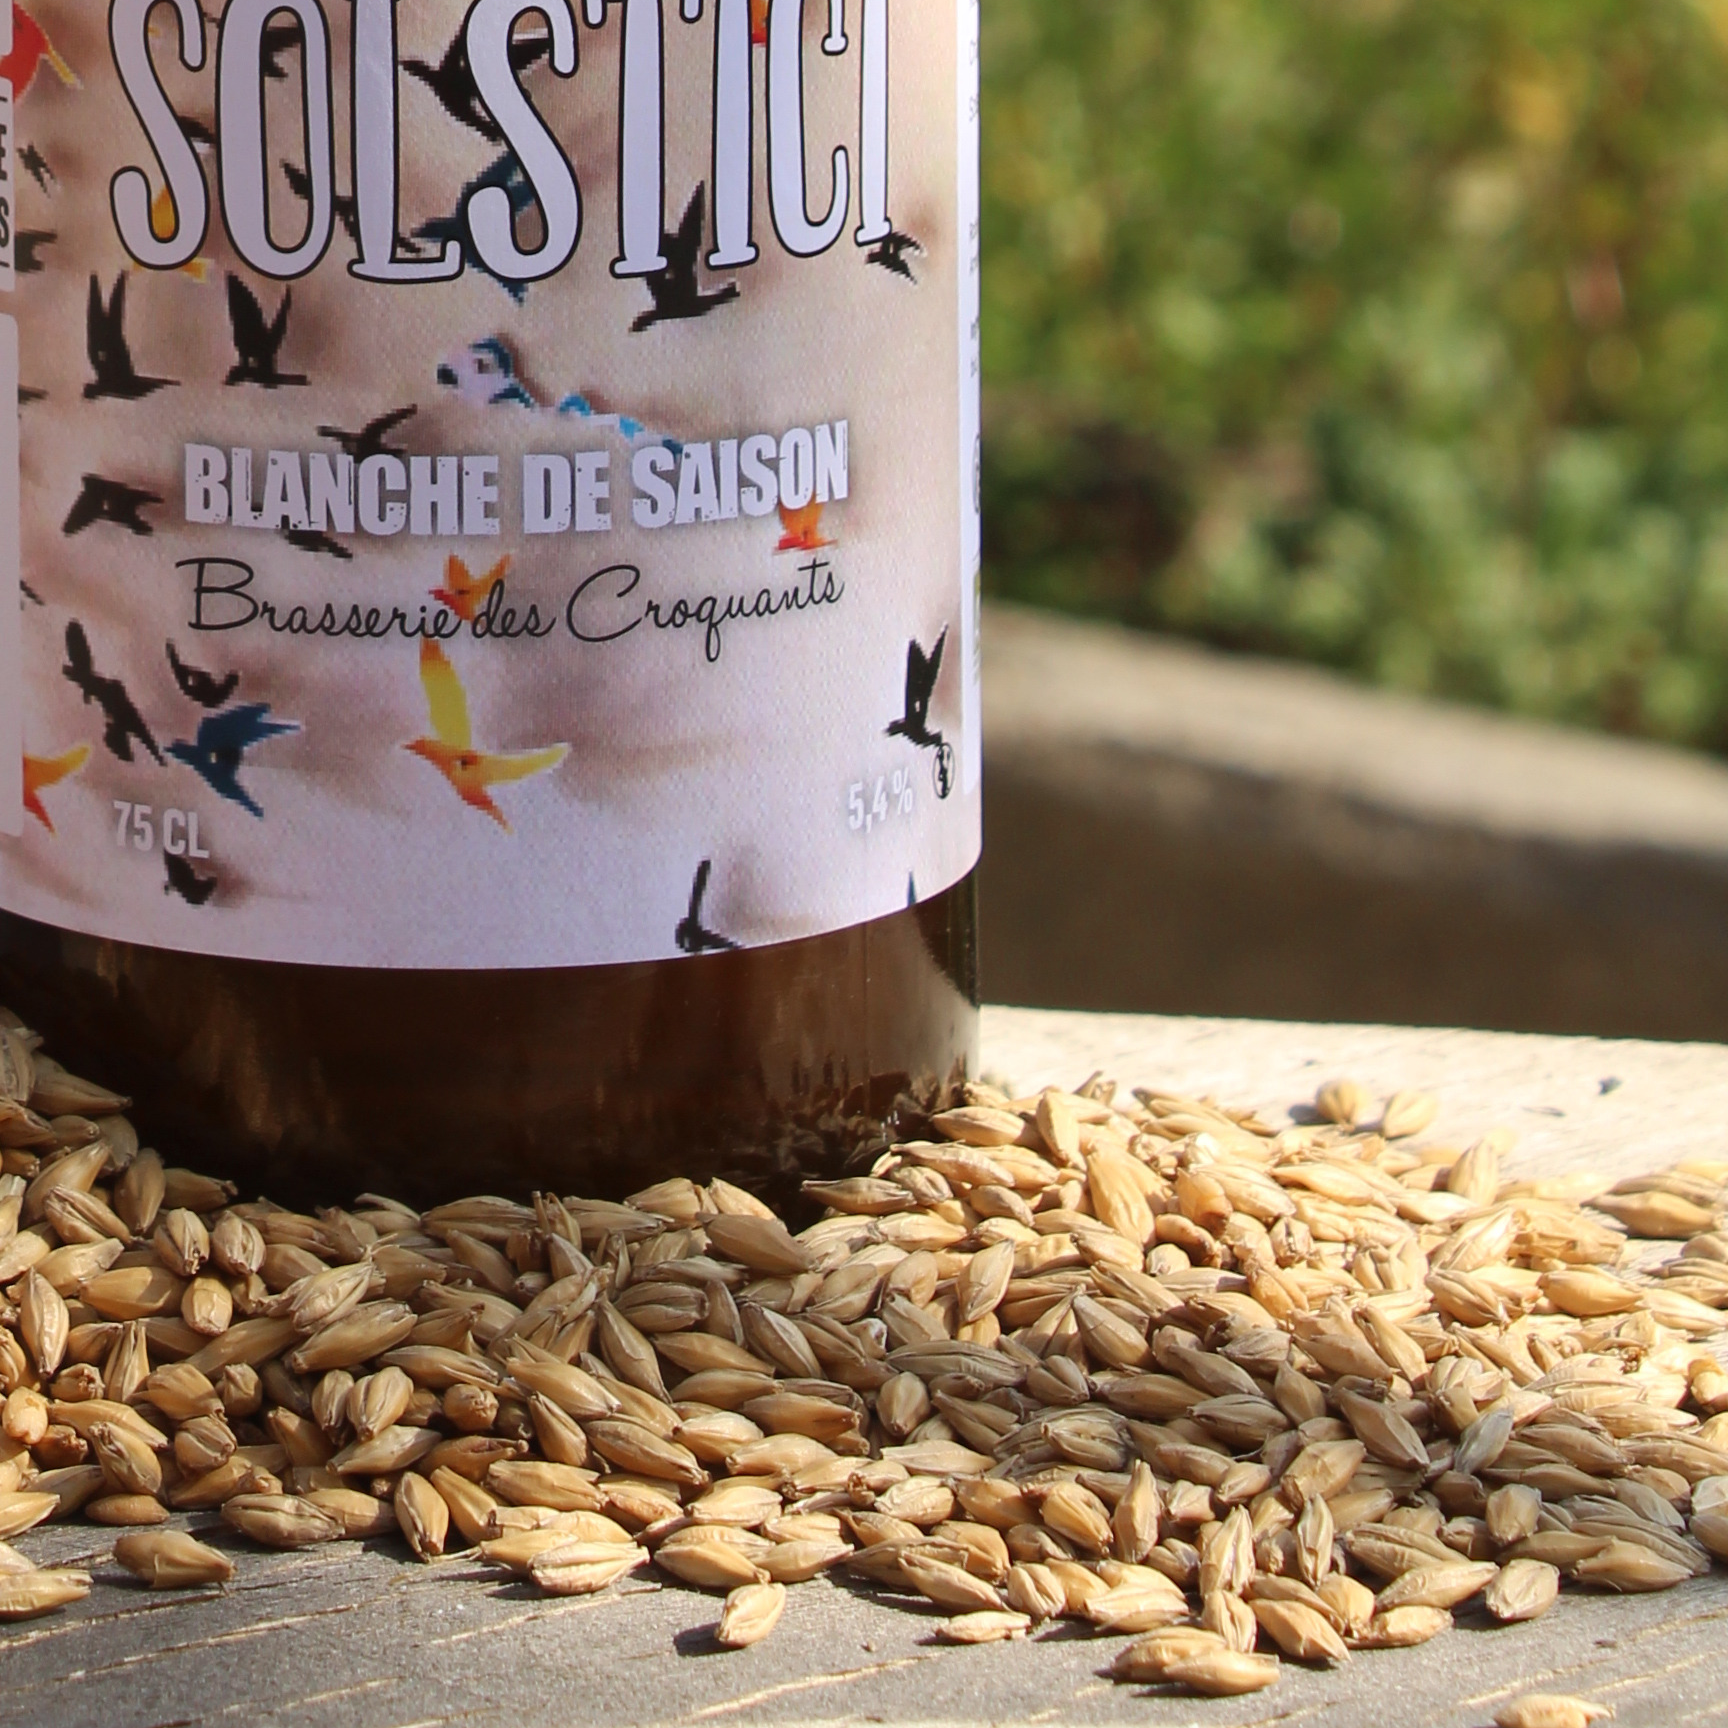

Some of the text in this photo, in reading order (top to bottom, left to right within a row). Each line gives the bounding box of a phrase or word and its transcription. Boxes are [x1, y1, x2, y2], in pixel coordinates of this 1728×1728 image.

[185, 419, 849, 536] BLANCHE DE SAISON
[175, 557, 846, 663] Brasserie des Croquants
[113, 799, 210, 859] 75 CL
